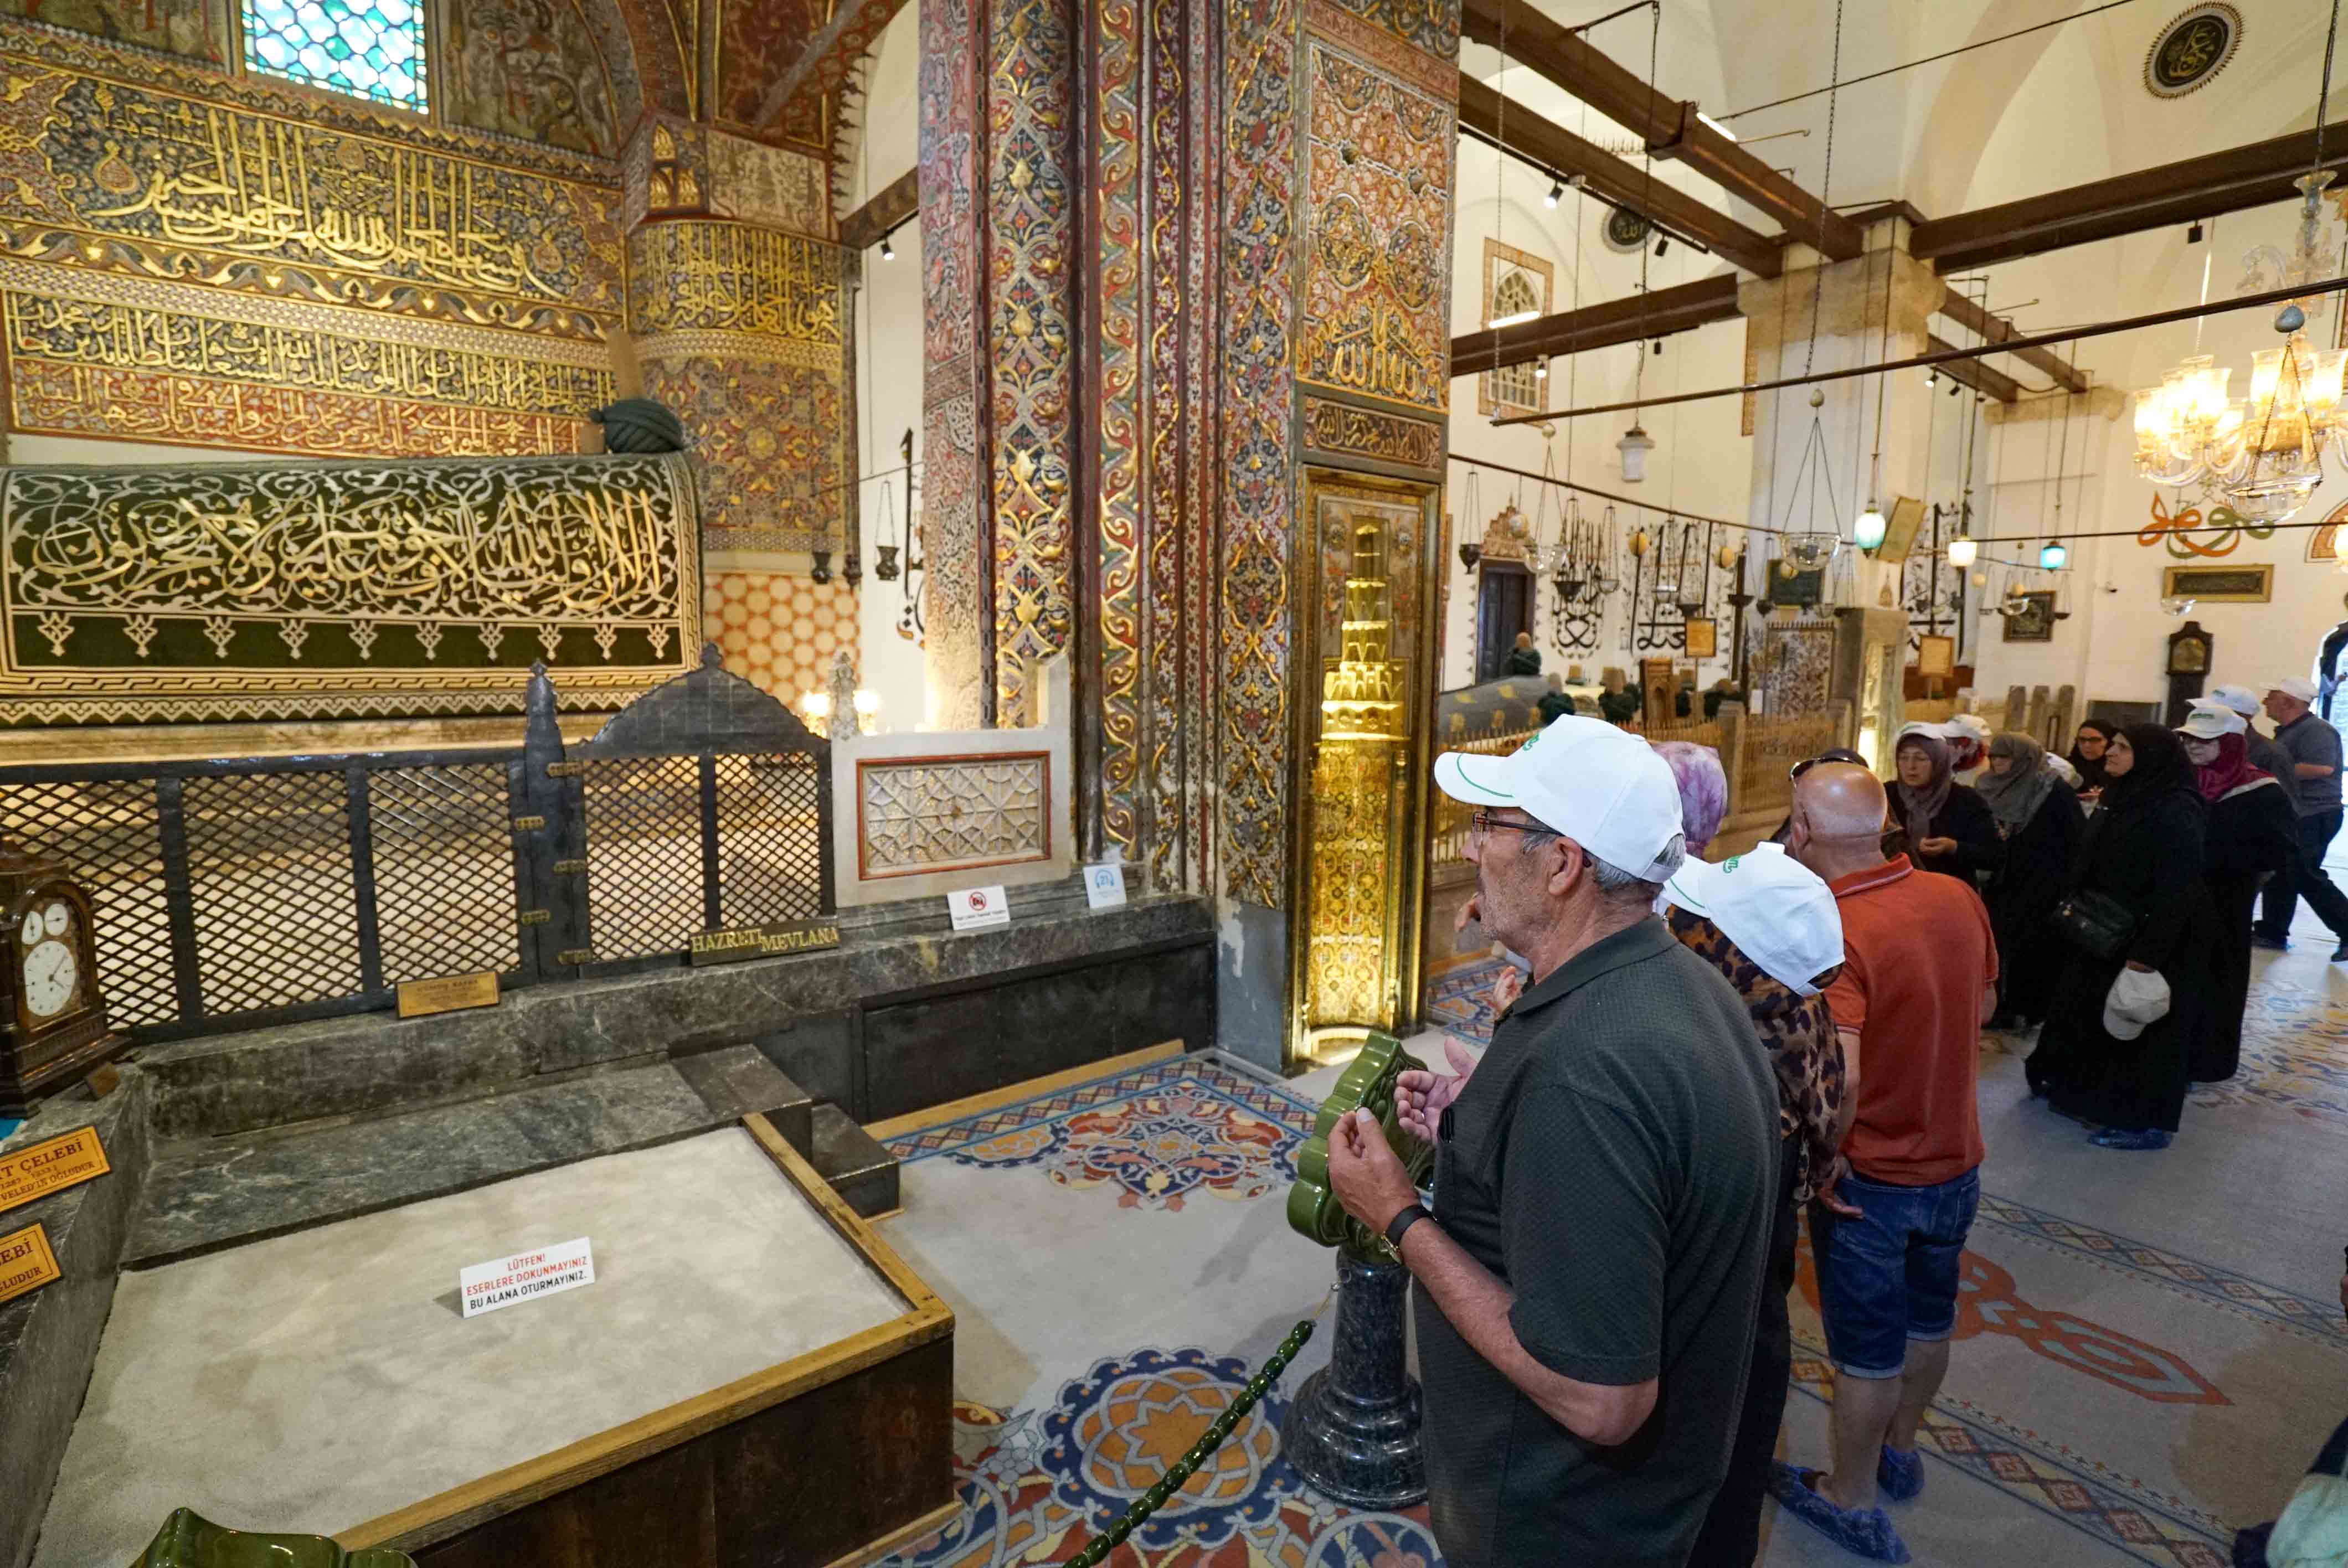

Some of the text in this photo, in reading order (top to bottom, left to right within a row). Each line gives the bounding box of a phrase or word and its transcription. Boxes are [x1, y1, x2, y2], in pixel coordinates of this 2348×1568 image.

[19, 1138, 84, 1174] ÇELEBİ
[467, 1256, 588, 1296] ESERLERE DOKUNMAYINIZ
[507, 1253, 545, 1272] LÜTFEN!
[470, 1271, 588, 1310] BU ALANA OTURMAYINIZ.
